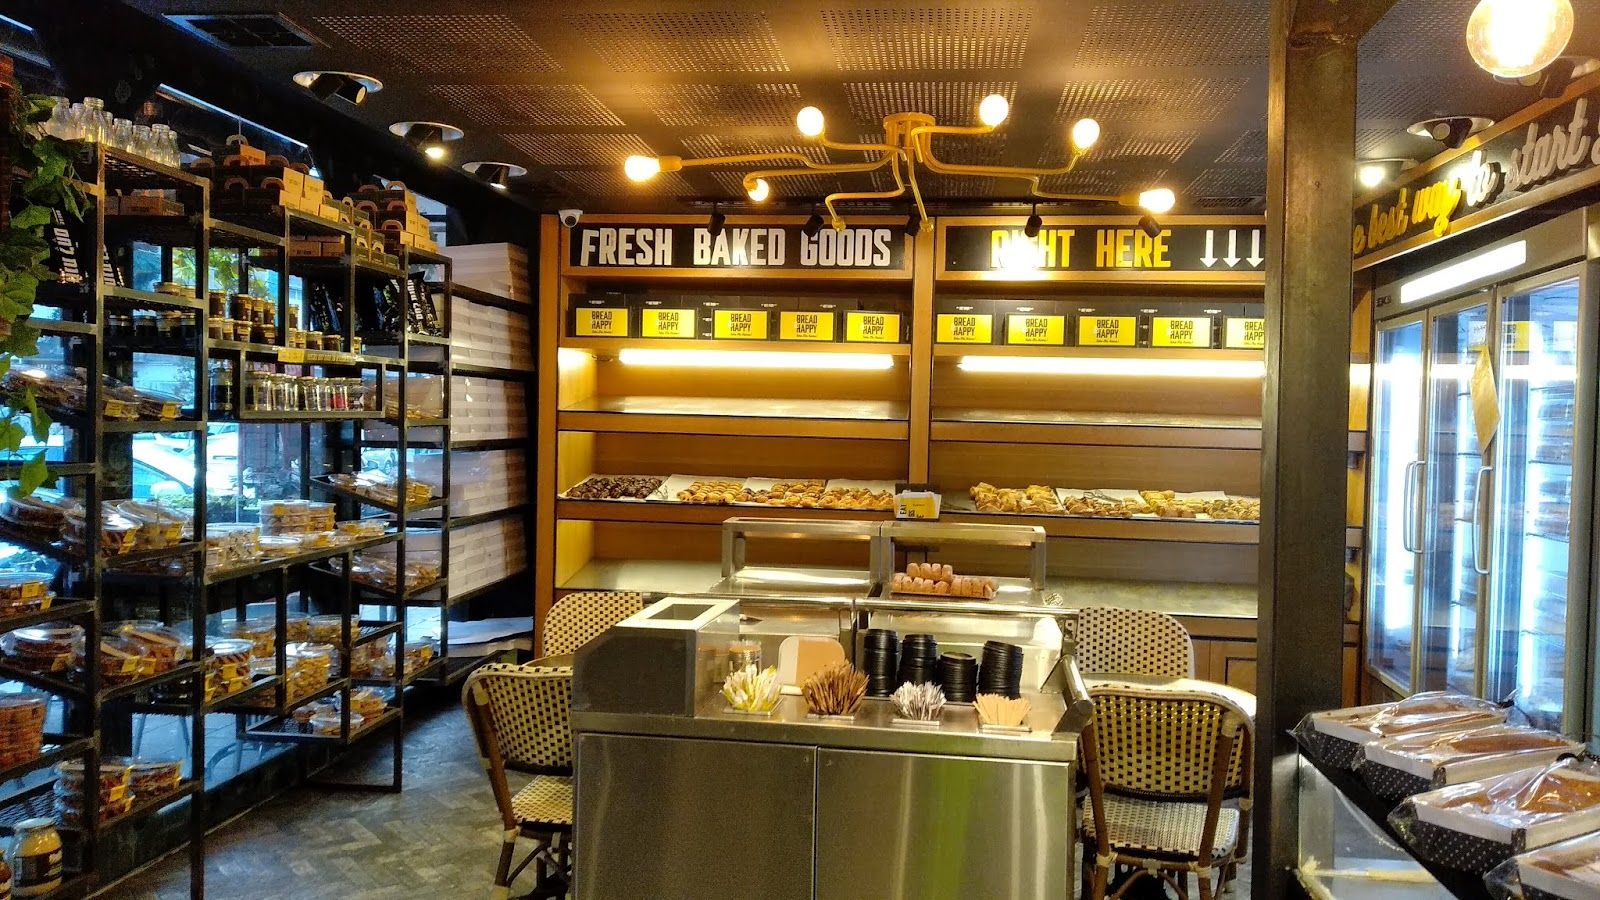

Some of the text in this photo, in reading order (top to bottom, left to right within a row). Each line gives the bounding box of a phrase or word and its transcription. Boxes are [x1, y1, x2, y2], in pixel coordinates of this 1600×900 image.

[1368, 187, 1408, 248] best
[1503, 97, 1591, 192] start
[580, 228, 892, 266] FRESH BAKED GOODS
[990, 229, 1172, 268] RHT HERE
[592, 311, 612, 320] BREAD
[658, 312, 678, 321] BREAD
[730, 314, 751, 322] BREAD
[796, 315, 817, 323] BREAD
[864, 316, 884, 325] BREAD
[954, 317, 975, 326] BREAD
[1026, 318, 1047, 327] BREAD
[1097, 320, 1119, 328] BREAD
[1170, 321, 1193, 329] BREAD
[592, 321, 612, 330] HAPPY
[659, 322, 678, 330] HAPPY
[731, 323, 750, 332] HAPPY
[796, 324, 816, 333] HAPPY
[863, 326, 883, 334] HAPPY
[1245, 321, 1264, 330] BREA
[954, 327, 974, 336] HAPPY
[1026, 328, 1046, 337] HAPPY
[1096, 329, 1118, 338] HAPPY
[1170, 330, 1192, 339] HAPPY
[1244, 332, 1264, 340] HAPP
